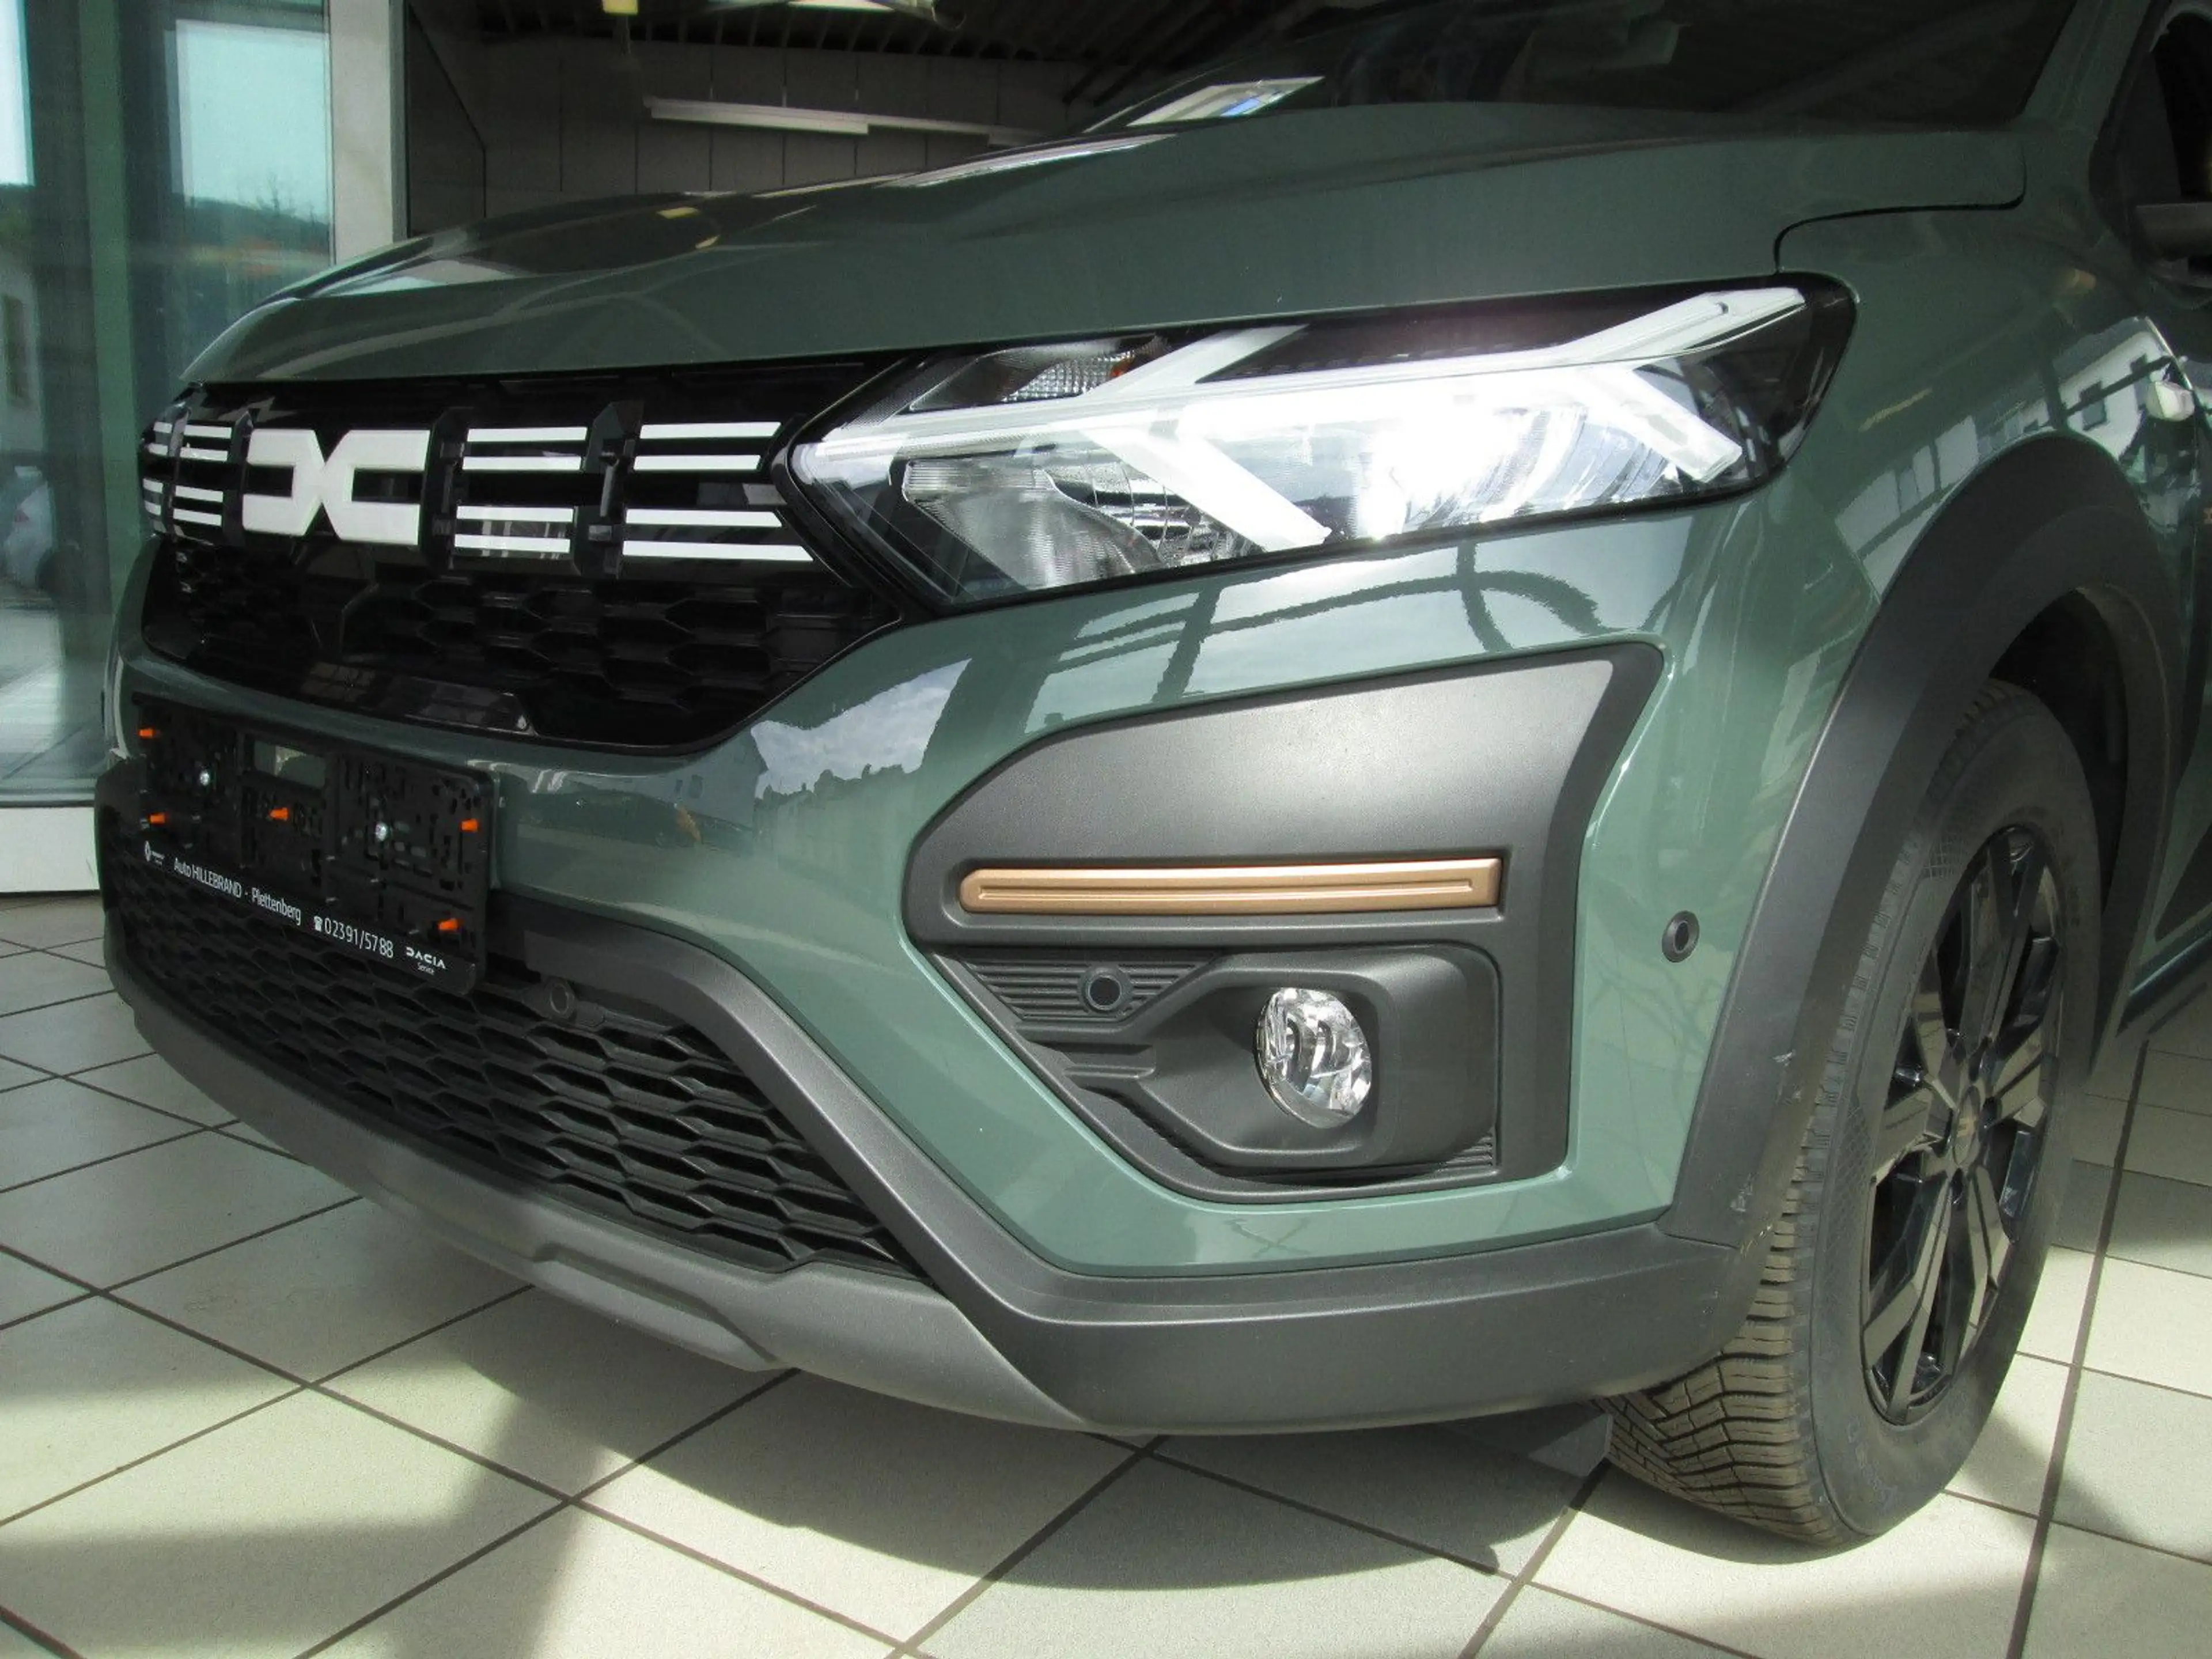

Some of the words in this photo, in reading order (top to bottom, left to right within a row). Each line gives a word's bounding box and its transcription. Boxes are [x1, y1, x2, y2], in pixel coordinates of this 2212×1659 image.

[174, 858, 191, 877] Auto
[192, 864, 242, 899] HILLEBRAND
[251, 887, 301, 926] Plettenberg
[405, 946, 446, 970] DACIA
